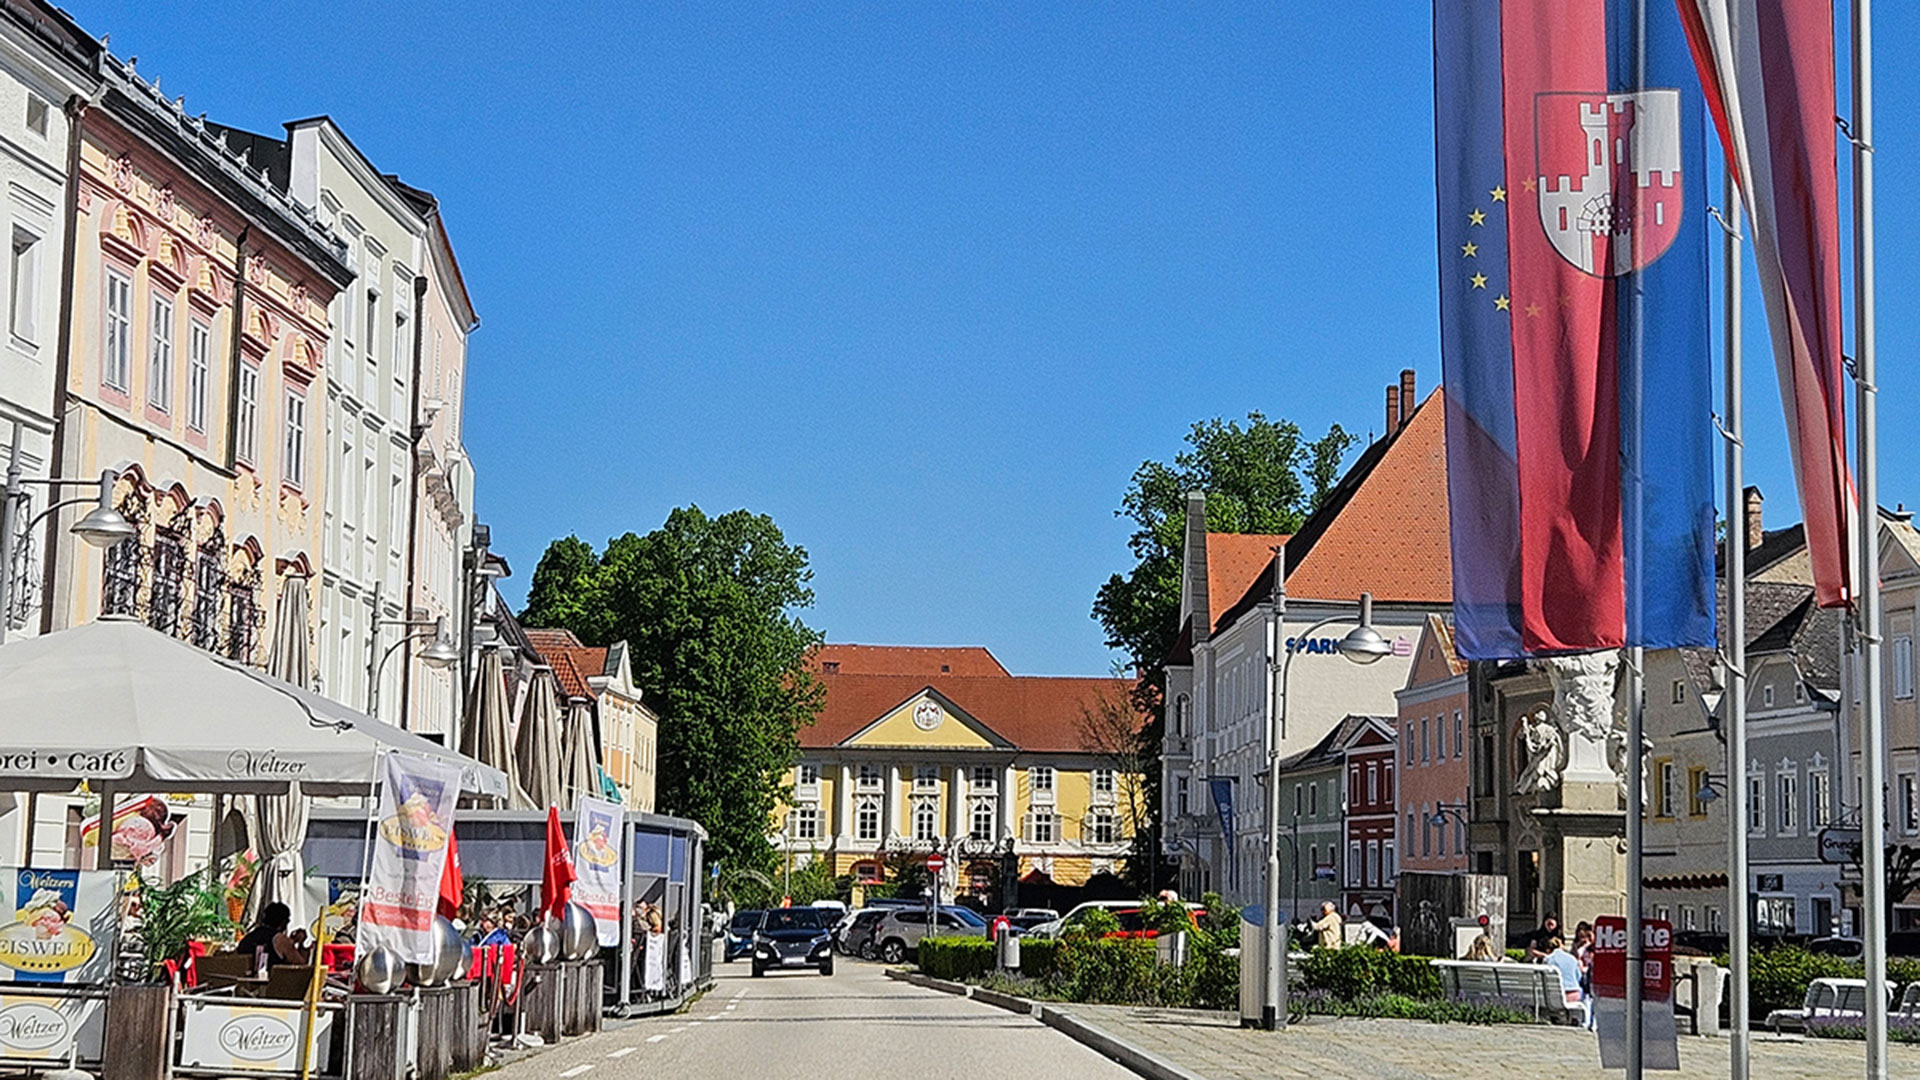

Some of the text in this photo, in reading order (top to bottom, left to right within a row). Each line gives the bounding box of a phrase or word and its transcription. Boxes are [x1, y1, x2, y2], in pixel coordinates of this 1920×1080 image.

[1285, 638, 1391, 655] SPARK
[0, 749, 125, 772] rei Café
[227, 748, 307, 777] Weltzer
[1595, 924, 1670, 949] Hete
[223, 1025, 291, 1050] Weltzer
